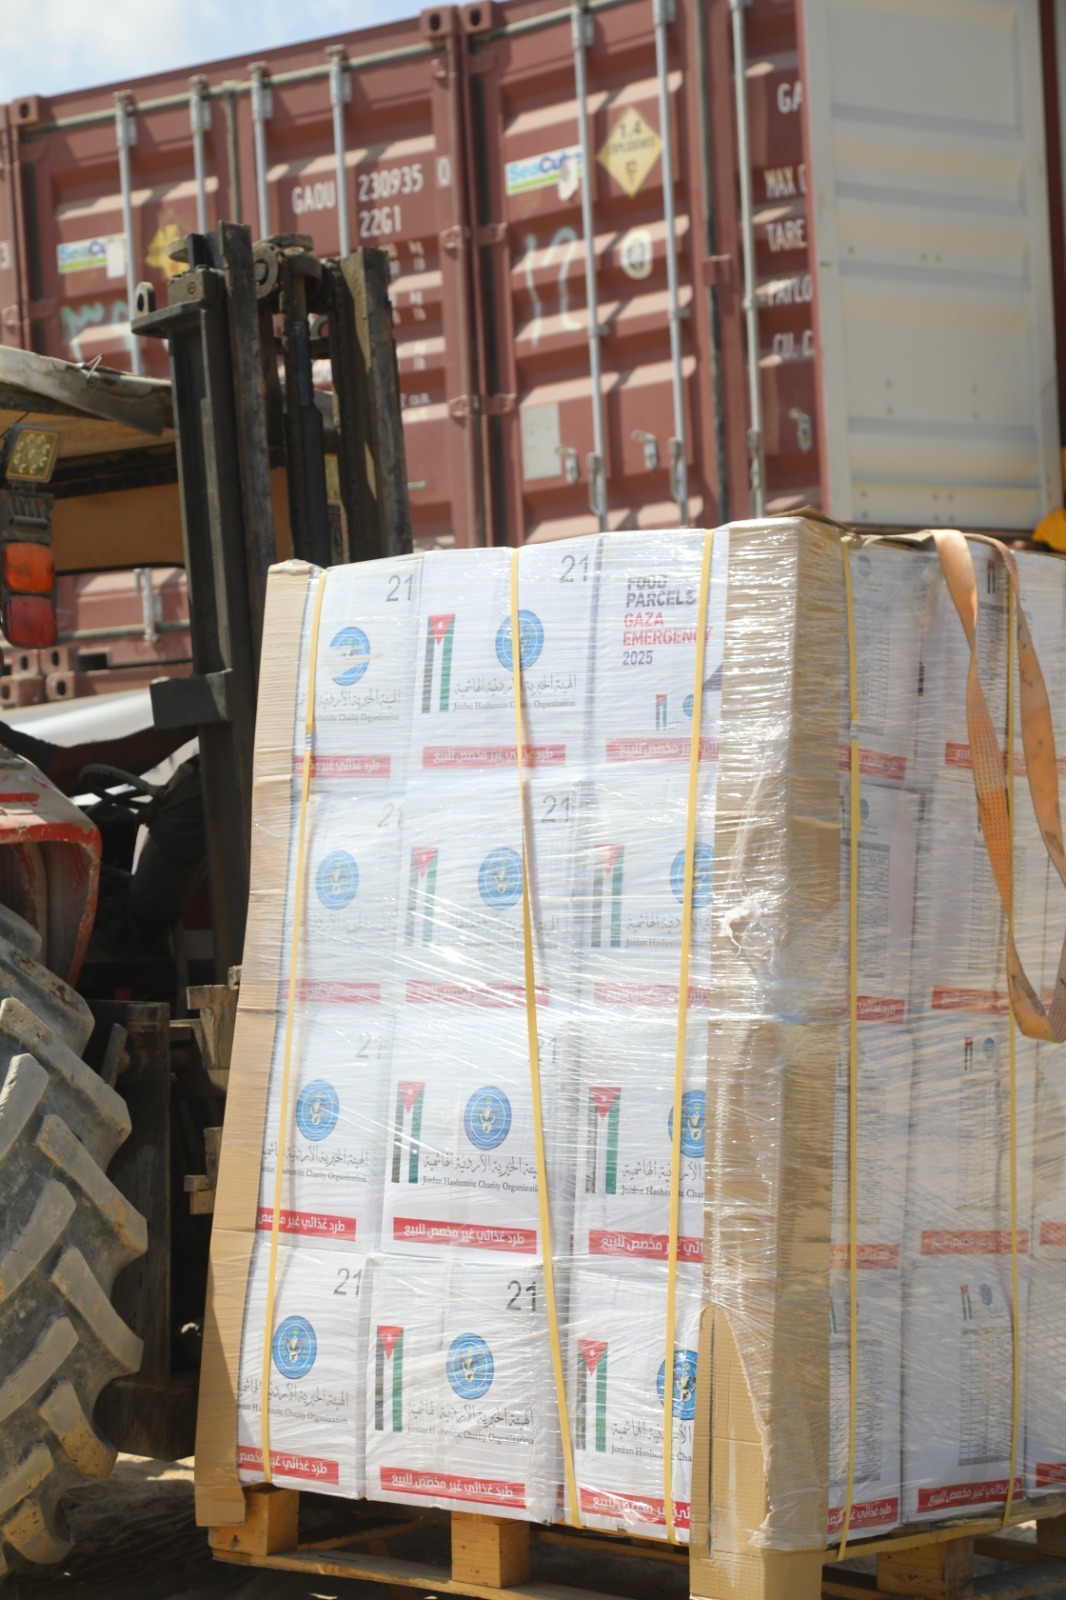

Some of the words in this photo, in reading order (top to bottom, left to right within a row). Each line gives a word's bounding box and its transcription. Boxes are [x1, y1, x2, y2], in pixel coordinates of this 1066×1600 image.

[507, 151, 583, 183] SeaCu
[358, 163, 424, 203] 230935
[765, 218, 807, 252] TARE
[559, 554, 589, 583] 21
[385, 574, 414, 602] 21
[626, 589, 697, 608] PARCELS
[623, 611, 664, 628] GAZA
[622, 650, 654, 666] 2025
[541, 795, 570, 823] 21
[422, 1176, 443, 1186] Jordan
[443, 1177, 477, 1188] Hashemite
[478, 1179, 501, 1192] Charity
[502, 1181, 539, 1193] Organizati
[328, 1219, 346, 1234] طرد
[404, 1223, 427, 1237] للبيع
[426, 1226, 459, 1240] مخصص
[460, 1229, 475, 1243] غير
[476, 1230, 506, 1244] غذائي
[508, 1234, 525, 1247] طرد
[601, 1236, 626, 1251] للبيع
[627, 1238, 663, 1251] مخصص
[333, 1267, 362, 1298] 21
[505, 1280, 537, 1312] 21
[307, 1411, 348, 1425] Organization
[283, 1458, 311, 1472] غذائي
[311, 1462, 328, 1475] طرد
[391, 1472, 414, 1486] للبيع
[415, 1476, 448, 1490] مخصص
[464, 1482, 495, 1496] غذائي
[496, 1486, 515, 1500] طرد
